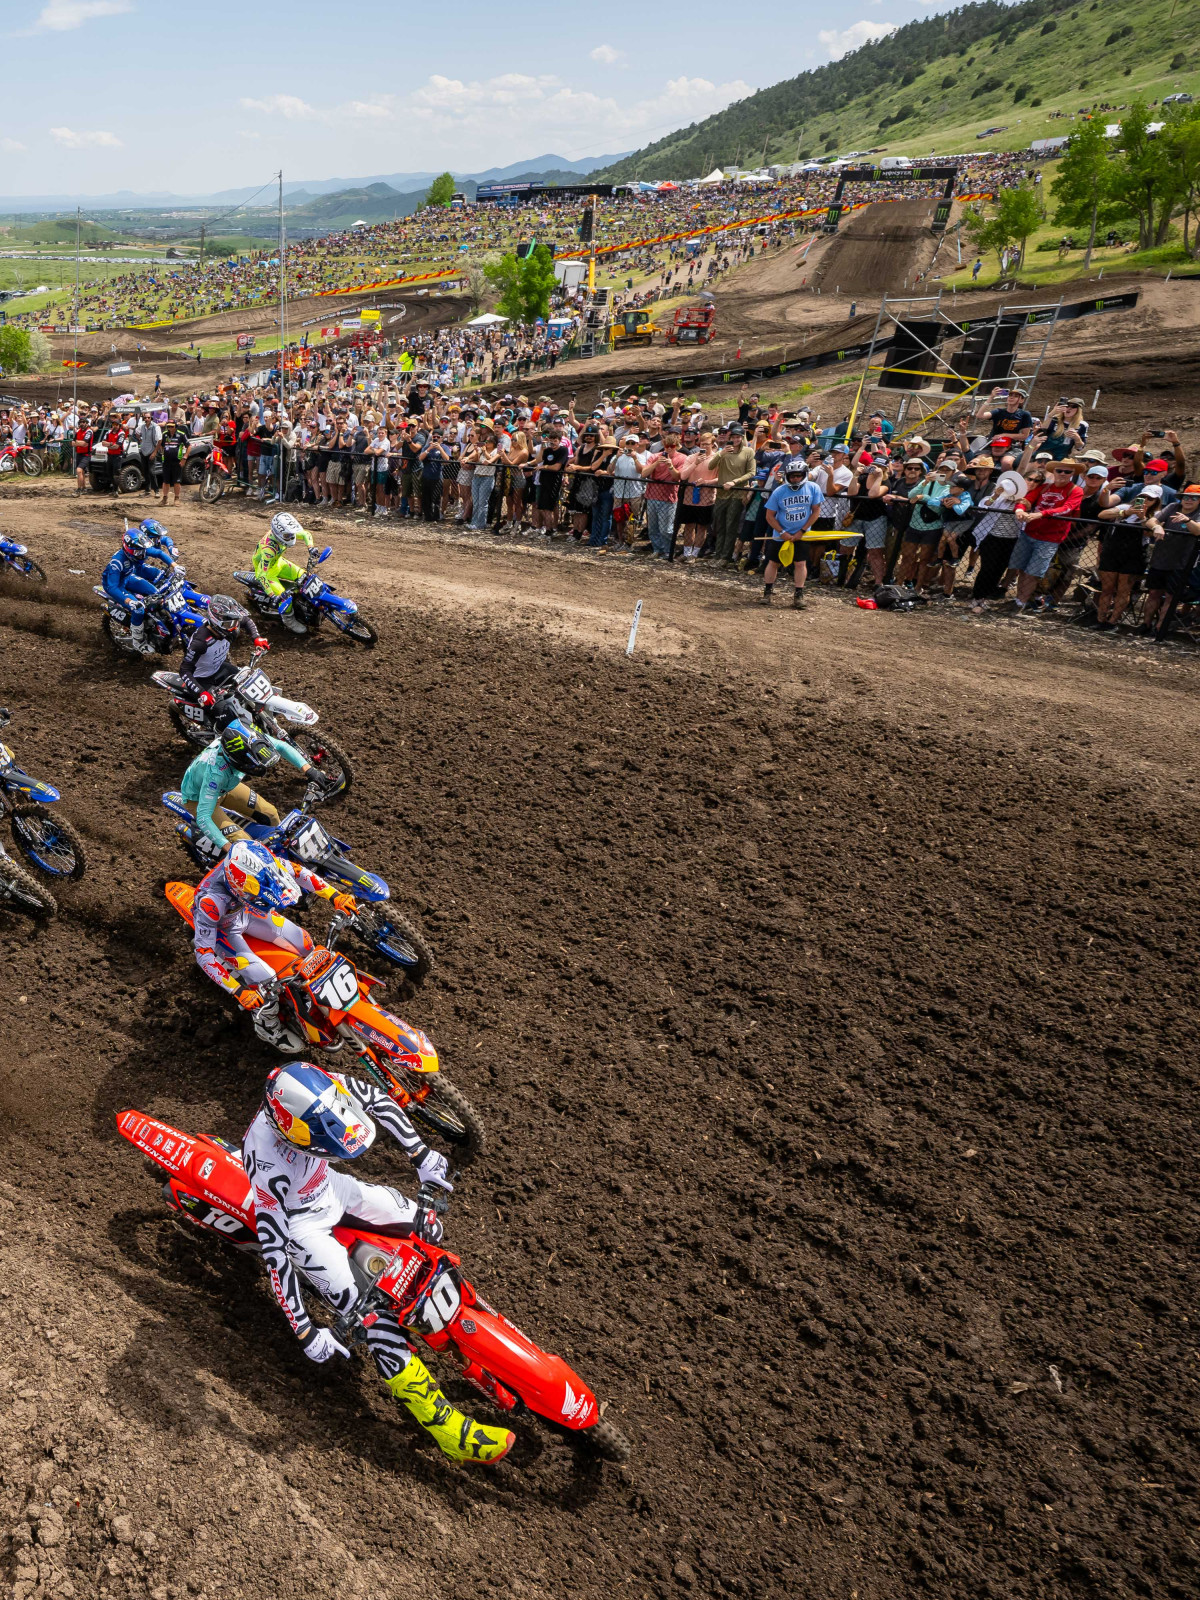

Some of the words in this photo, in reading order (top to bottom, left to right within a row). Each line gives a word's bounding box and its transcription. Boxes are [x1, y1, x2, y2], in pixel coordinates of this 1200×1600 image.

[783, 495, 810, 506] TRACK
[785, 511, 807, 522] CREW
[304, 576, 324, 599] 784
[109, 607, 127, 622] 443
[167, 591, 187, 613] 443
[181, 673, 200, 694] SEVEN
[245, 676, 272, 701] 99
[184, 704, 204, 722] 99
[166, 801, 186, 814] DUNLOP
[318, 963, 358, 1010] 16
[149, 1120, 198, 1145] DUNLOP
[136, 1140, 180, 1171] DUNLOP
[203, 1189, 249, 1221] HONDA
[202, 1206, 244, 1234] 10
[391, 1254, 419, 1296] RENTHAL
[396, 1259, 423, 1299] RENTHAL
[270, 1267, 300, 1334] HONDA
[422, 1272, 461, 1334] 10
[568, 1393, 586, 1420] HONDA
